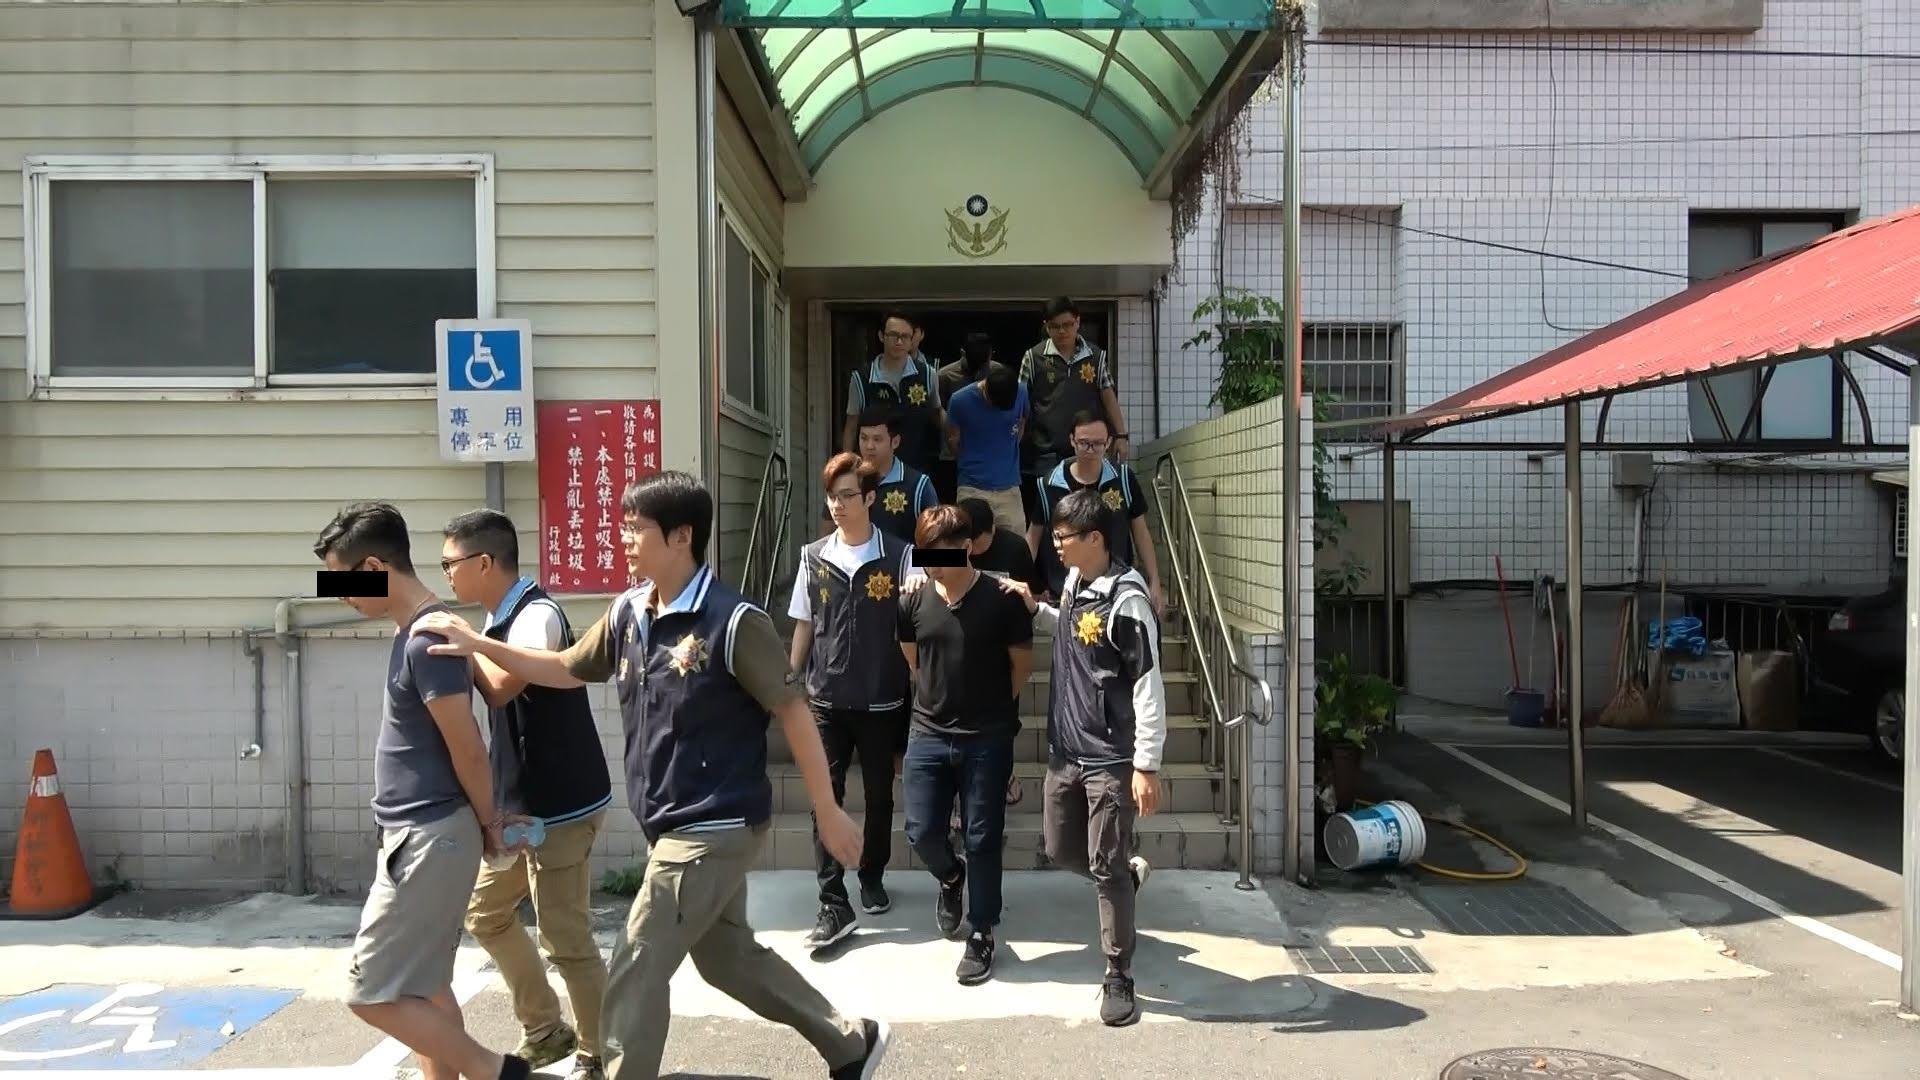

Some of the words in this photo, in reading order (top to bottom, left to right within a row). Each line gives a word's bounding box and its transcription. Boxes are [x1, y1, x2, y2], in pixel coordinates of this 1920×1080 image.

[450, 406, 523, 427] 專用
[450, 430, 524, 451] 停車位
[623, 404, 637, 484] 敬請各位同
[567, 408, 586, 586] 二、禁止亂丟垃圾。
[595, 409, 615, 584] 一、本處禁止吸煙。
